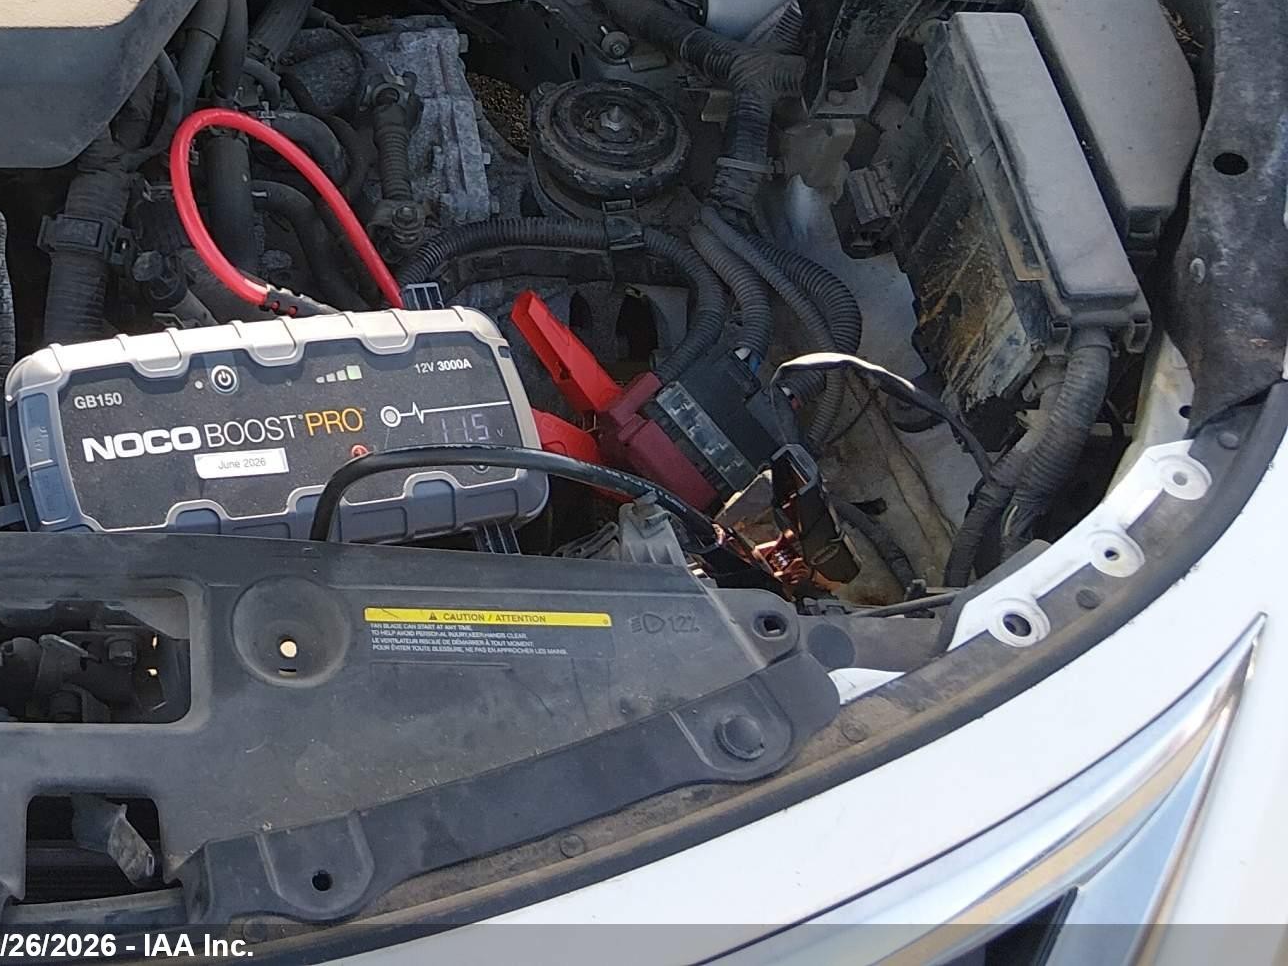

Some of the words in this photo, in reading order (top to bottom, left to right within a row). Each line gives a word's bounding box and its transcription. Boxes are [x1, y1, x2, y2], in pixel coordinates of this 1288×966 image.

[414, 363, 434, 374] 12V
[437, 358, 472, 371] 3000A
[73, 392, 123, 410] GB150
[82, 425, 202, 462] NOCO
[304, 407, 364, 436] PRO
[217, 459, 240, 470] June
[243, 457, 266, 468] 2026
[443, 613, 485, 622] CAUTION
[495, 614, 546, 623] ATTENTION
